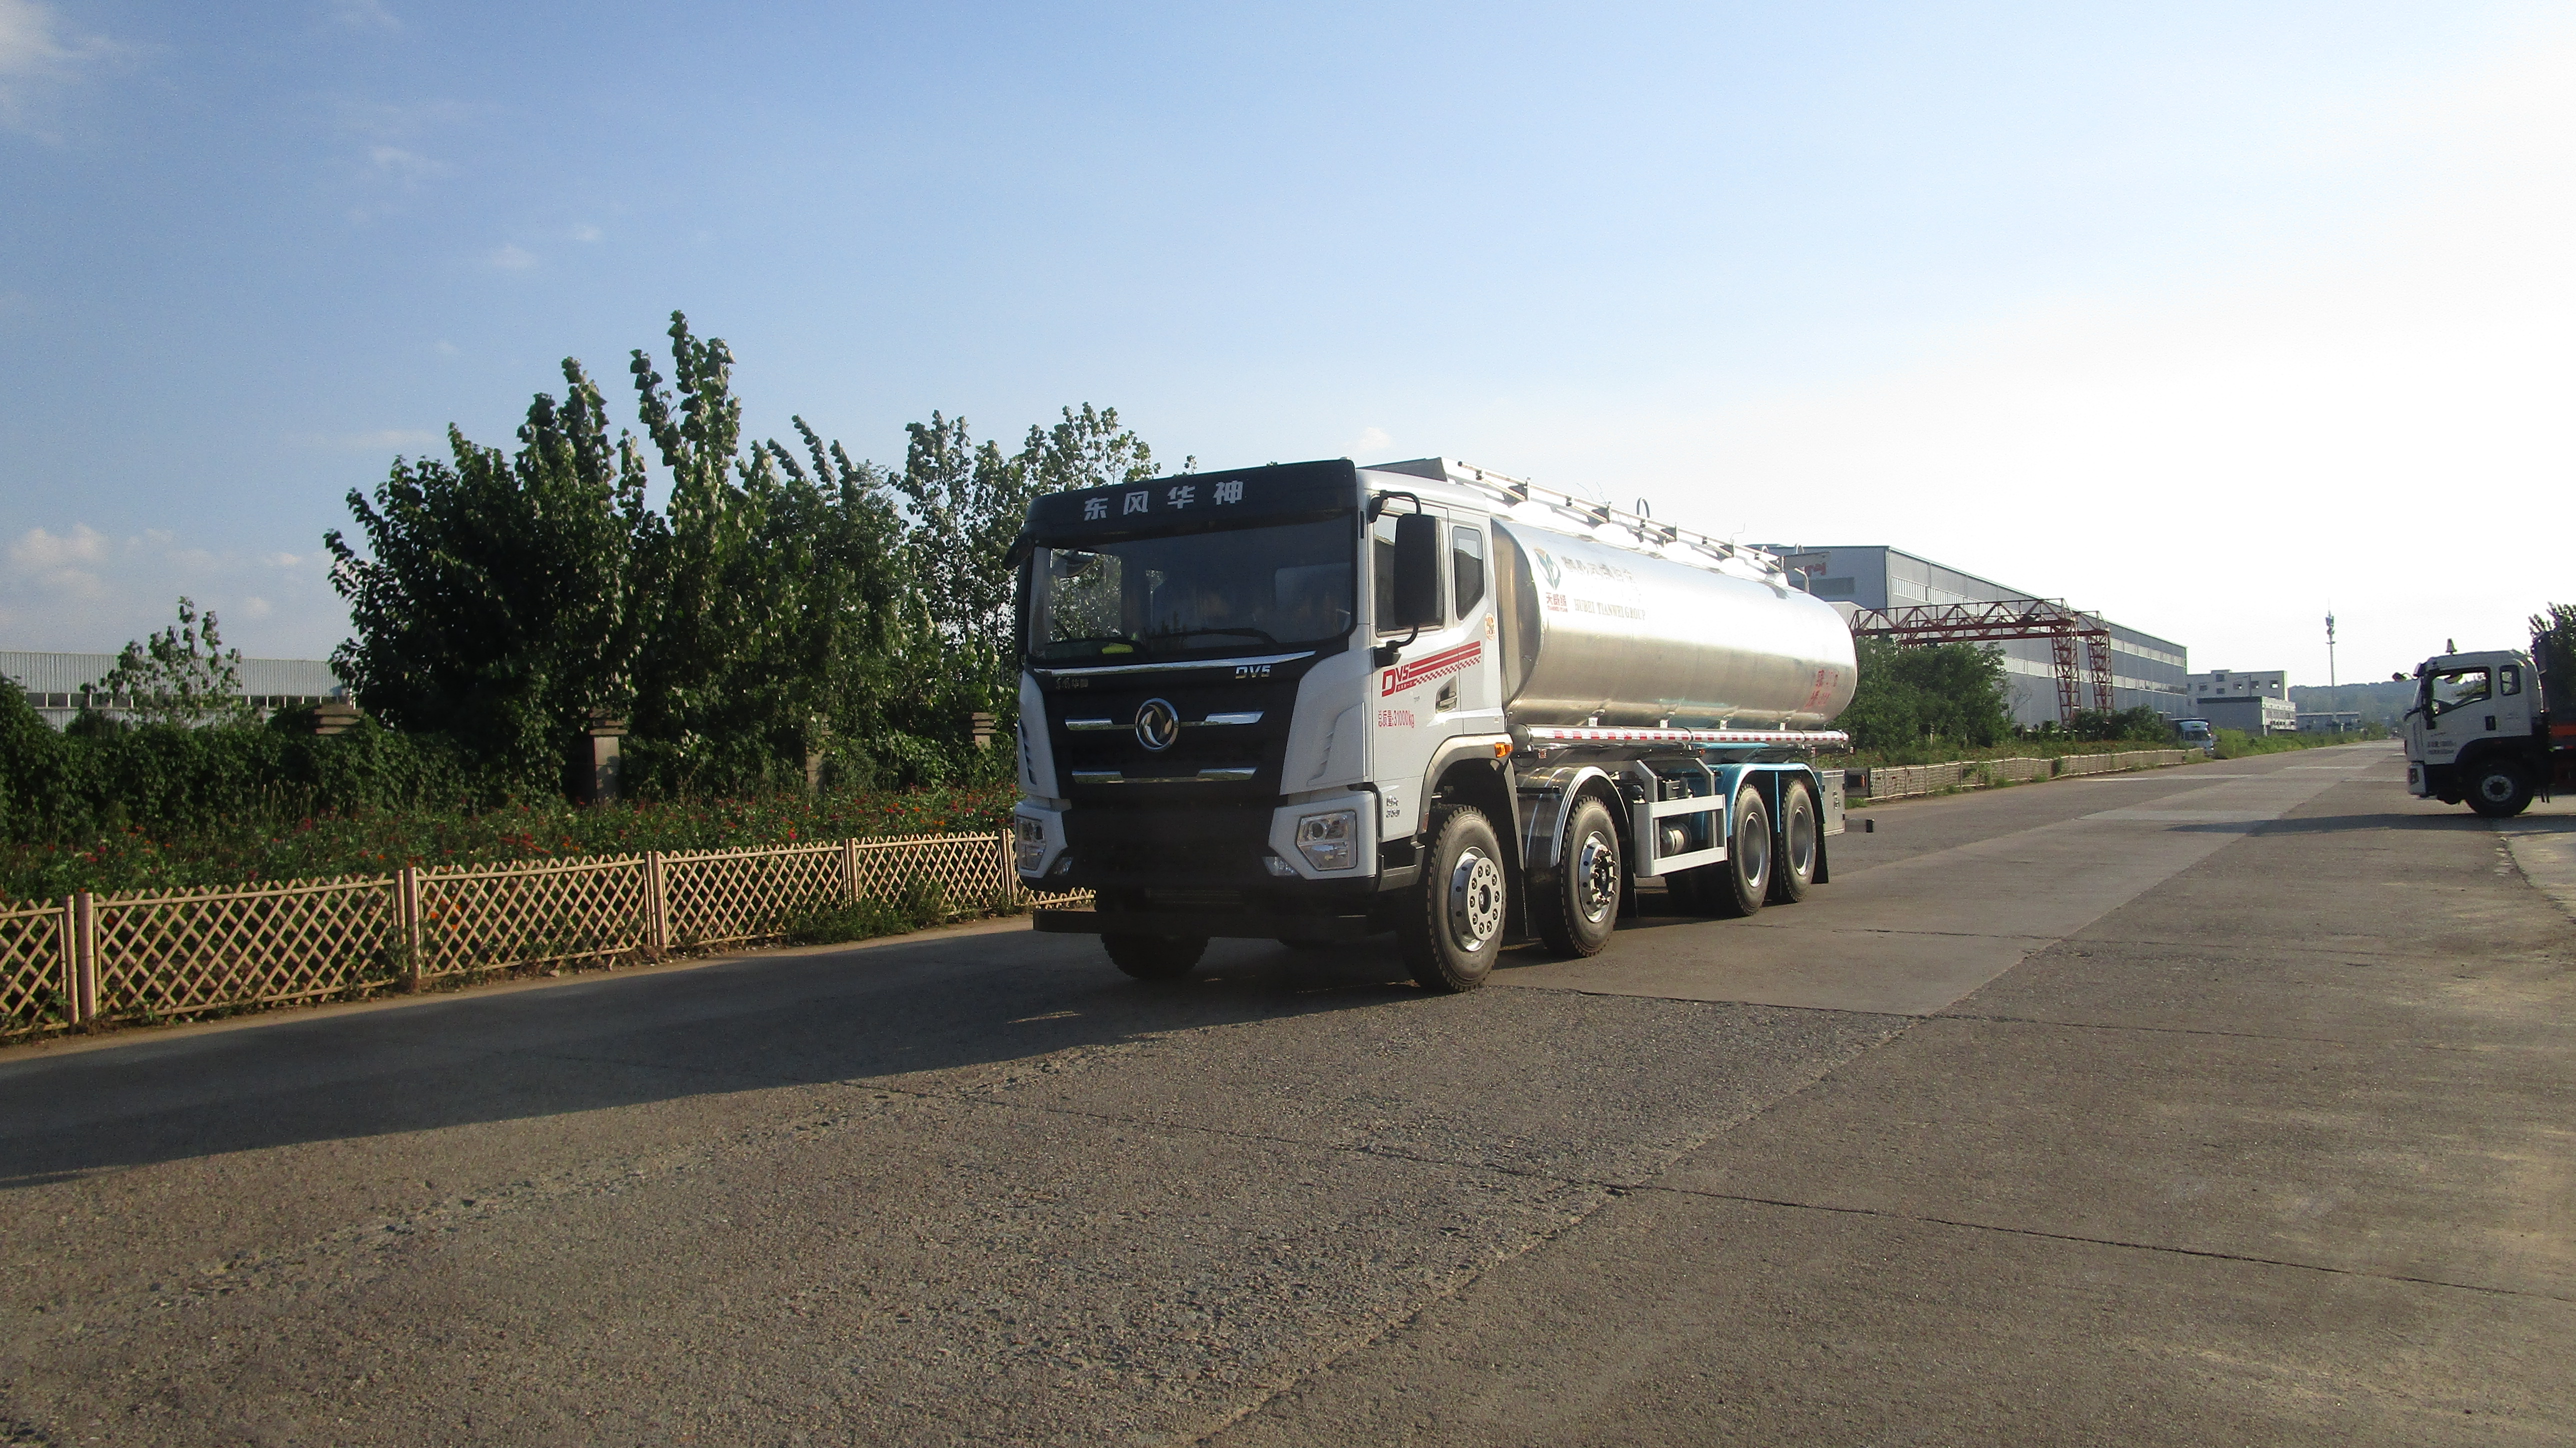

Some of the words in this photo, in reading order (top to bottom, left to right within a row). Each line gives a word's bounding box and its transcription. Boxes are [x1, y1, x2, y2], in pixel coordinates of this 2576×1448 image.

[1084, 480, 1244, 521] 东风华神
[1574, 598, 1596, 614] HUBEI
[1596, 602, 1624, 618] TIANWEI
[1625, 606, 1646, 620] GROUP
[1235, 664, 1272, 679] DV5
